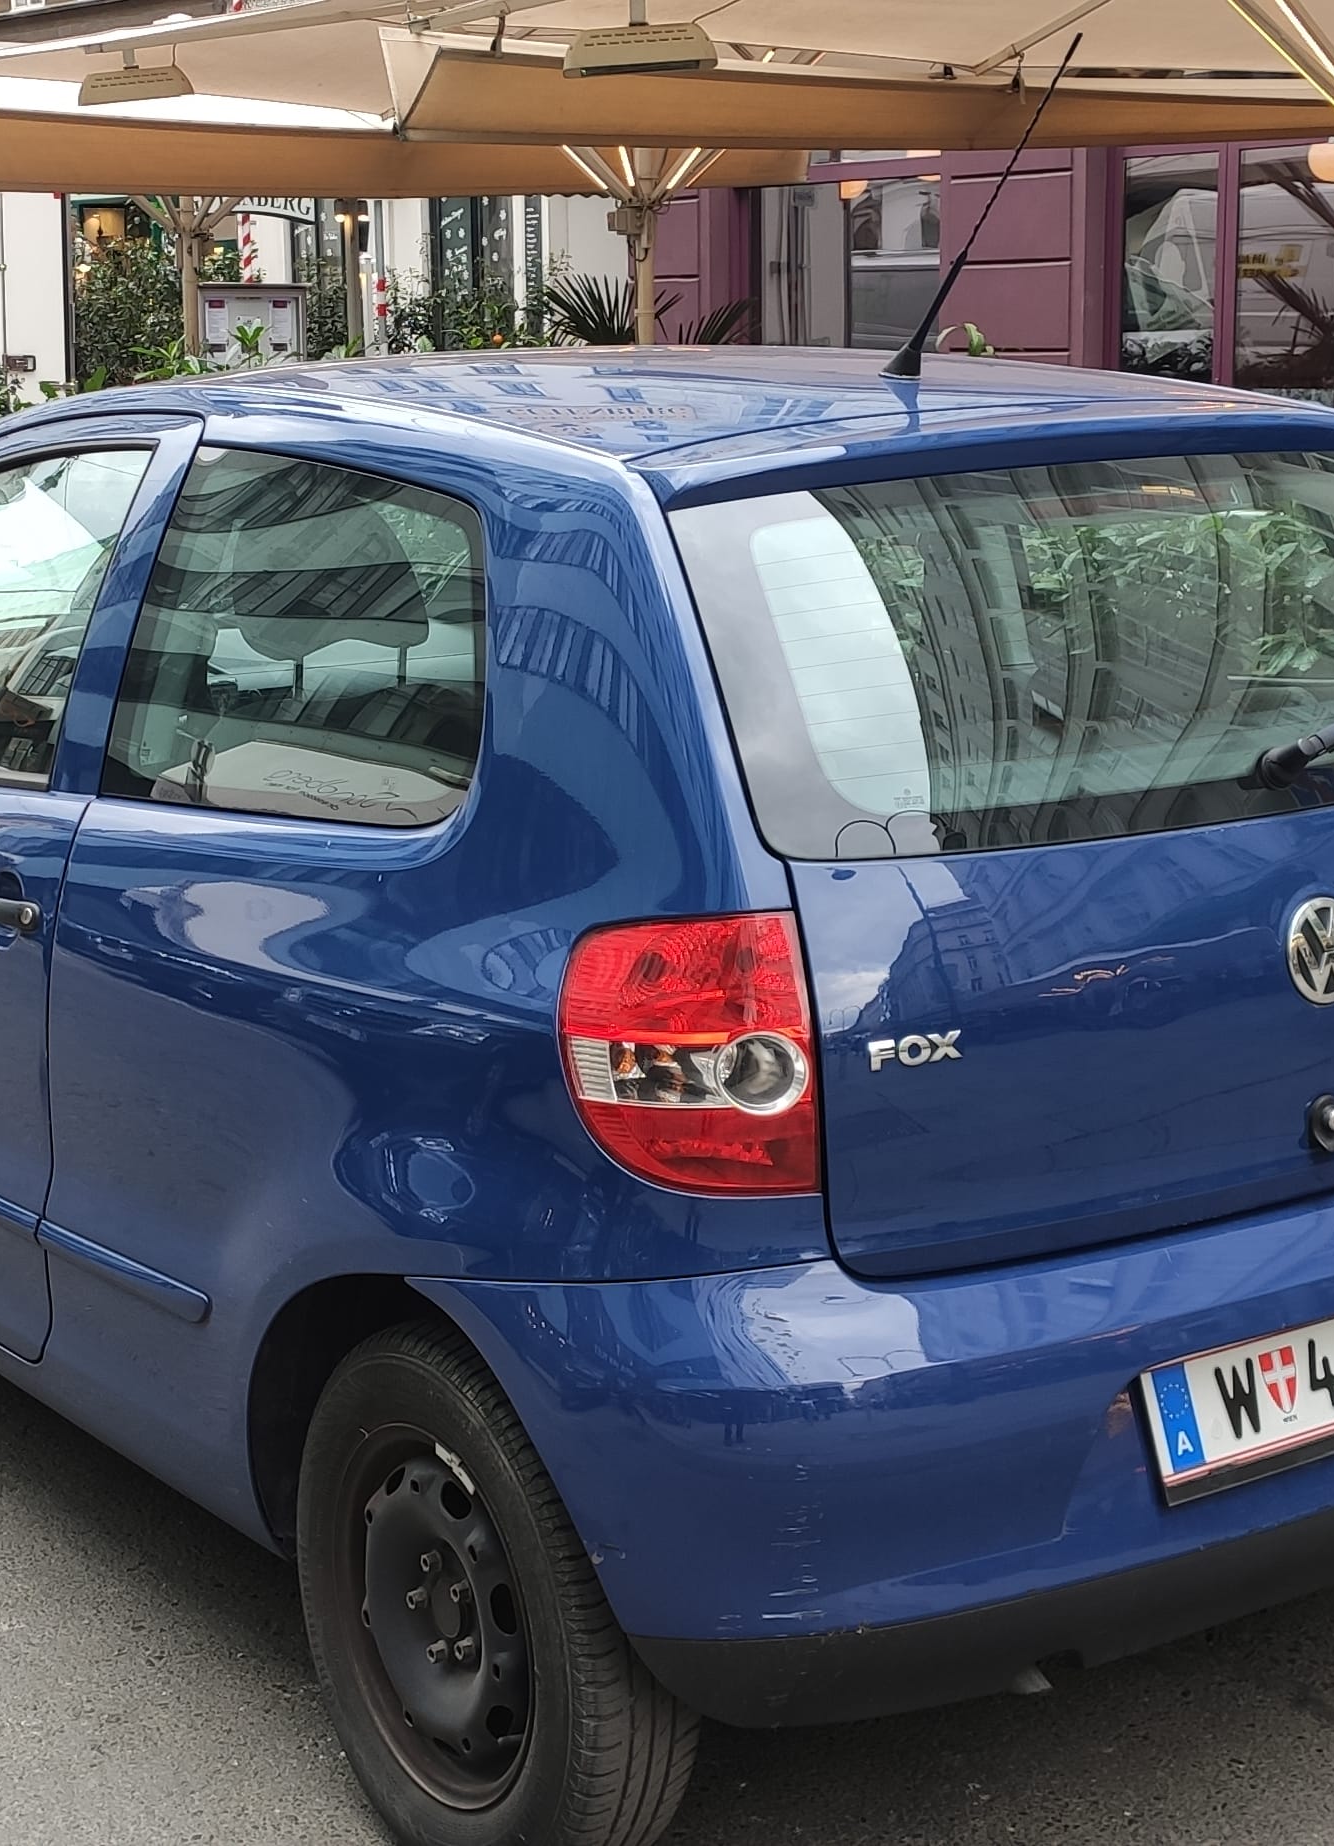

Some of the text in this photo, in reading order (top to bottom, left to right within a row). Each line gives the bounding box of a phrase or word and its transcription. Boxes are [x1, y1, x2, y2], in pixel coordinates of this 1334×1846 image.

[868, 1030, 963, 1072] FOX
[1214, 1357, 1262, 1440] W
[1176, 1430, 1195, 1457] A
